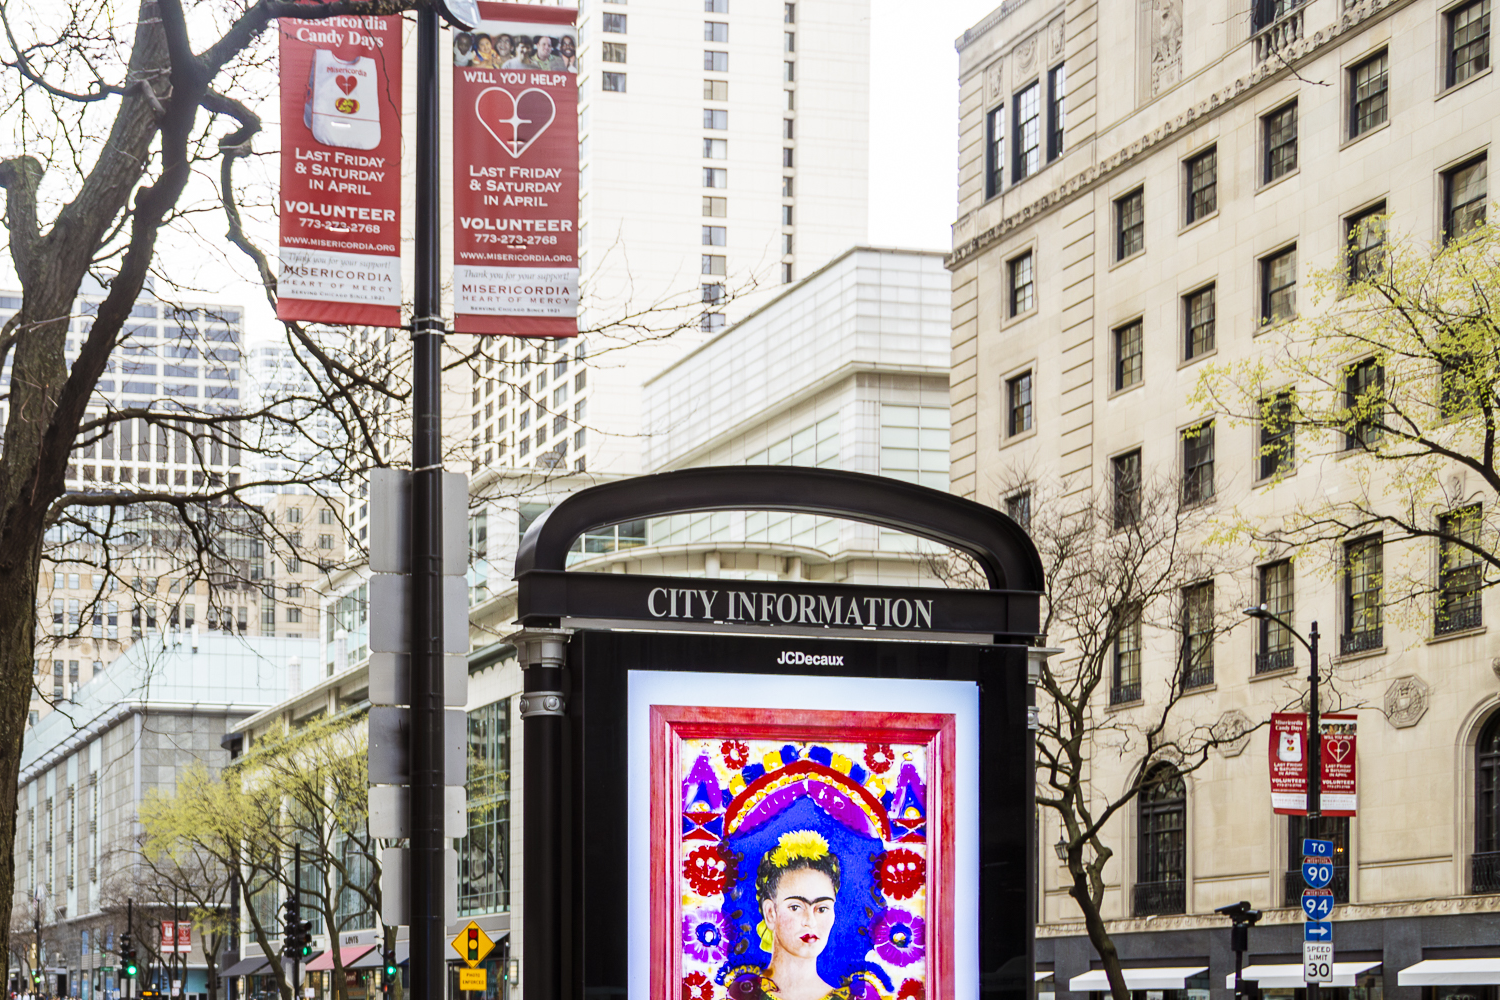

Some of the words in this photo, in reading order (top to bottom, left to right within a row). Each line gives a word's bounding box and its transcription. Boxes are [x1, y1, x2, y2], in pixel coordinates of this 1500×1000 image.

[296, 27, 345, 48] Candy
[348, 31, 384, 50] Days
[326, 66, 368, 77] Misericordia
[463, 70, 497, 84] WILL
[500, 72, 527, 85] YOU
[530, 73, 567, 87] HELP?
[295, 147, 332, 163] LAST
[334, 151, 386, 168] FRIDAY
[295, 162, 307, 175] &
[311, 163, 385, 182] SATURDAY
[469, 164, 506, 178] LAST
[509, 166, 562, 179] FRIDAY
[309, 179, 324, 191] IN
[328, 180, 372, 195] APRIL
[469, 179, 482, 191] &
[486, 179, 562, 193] SATURDAY
[483, 194, 499, 206] IN
[503, 194, 548, 207] APRIL
[284, 200, 396, 222] VOLUNTEER
[298, 217, 381, 234] 773-273-2768
[460, 216, 573, 232] VOLUNTEER
[283, 236, 396, 252] WWW.MISERICORDIA.ORG
[474, 233, 558, 245] 773-273-2768
[288, 252, 311, 263] Thank
[313, 256, 327, 266] you
[327, 256, 340, 267] for
[340, 260, 358, 269] your
[359, 260, 391, 270] support!
[460, 251, 573, 262] WWW.MISERICORDIA.ORG
[283, 265, 392, 282] MISERICORDIA
[464, 269, 489, 279] Thank
[489, 271, 504, 281] you
[504, 270, 516, 281] for
[517, 272, 535, 282] your
[537, 271, 570, 283] support!
[283, 279, 324, 288] HEART
[352, 284, 393, 293] MERCY
[462, 284, 570, 295] MISERICORDIA
[462, 295, 501, 303] HEART
[647, 587, 719, 619] CITY
[726, 591, 934, 629] INFORMATION
[777, 651, 844, 666] JCDecaux
[1311, 842, 1326, 854] TO
[1307, 866, 1329, 882] 90
[1306, 899, 1328, 914] 94
[1306, 945, 1331, 953] SPEED
[1307, 962, 1330, 978] 30
